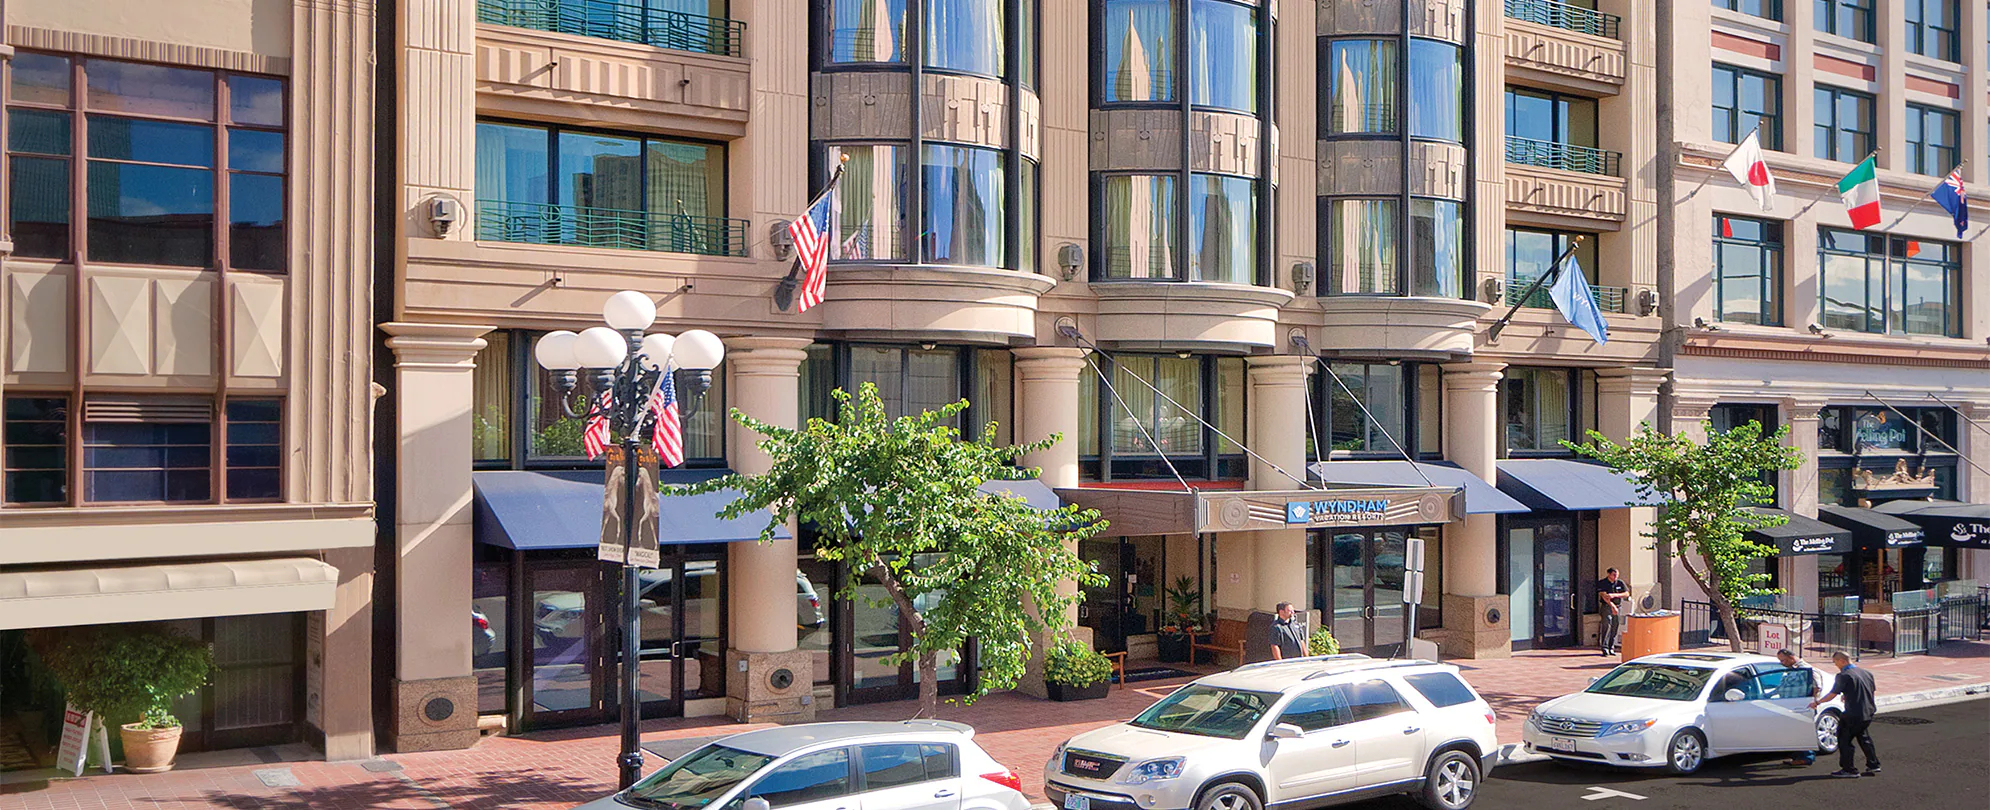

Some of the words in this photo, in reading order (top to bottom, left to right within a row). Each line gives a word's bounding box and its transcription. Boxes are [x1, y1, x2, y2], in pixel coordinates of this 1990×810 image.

[1862, 419, 1875, 429] The
[1889, 428, 1906, 442] Pot
[1313, 500, 1388, 514] WYNDHAM
[1313, 512, 1351, 522] VACATION
[1352, 511, 1386, 520] RESORTS
[1766, 630, 1780, 639] Lot
[1764, 641, 1782, 649] Full
